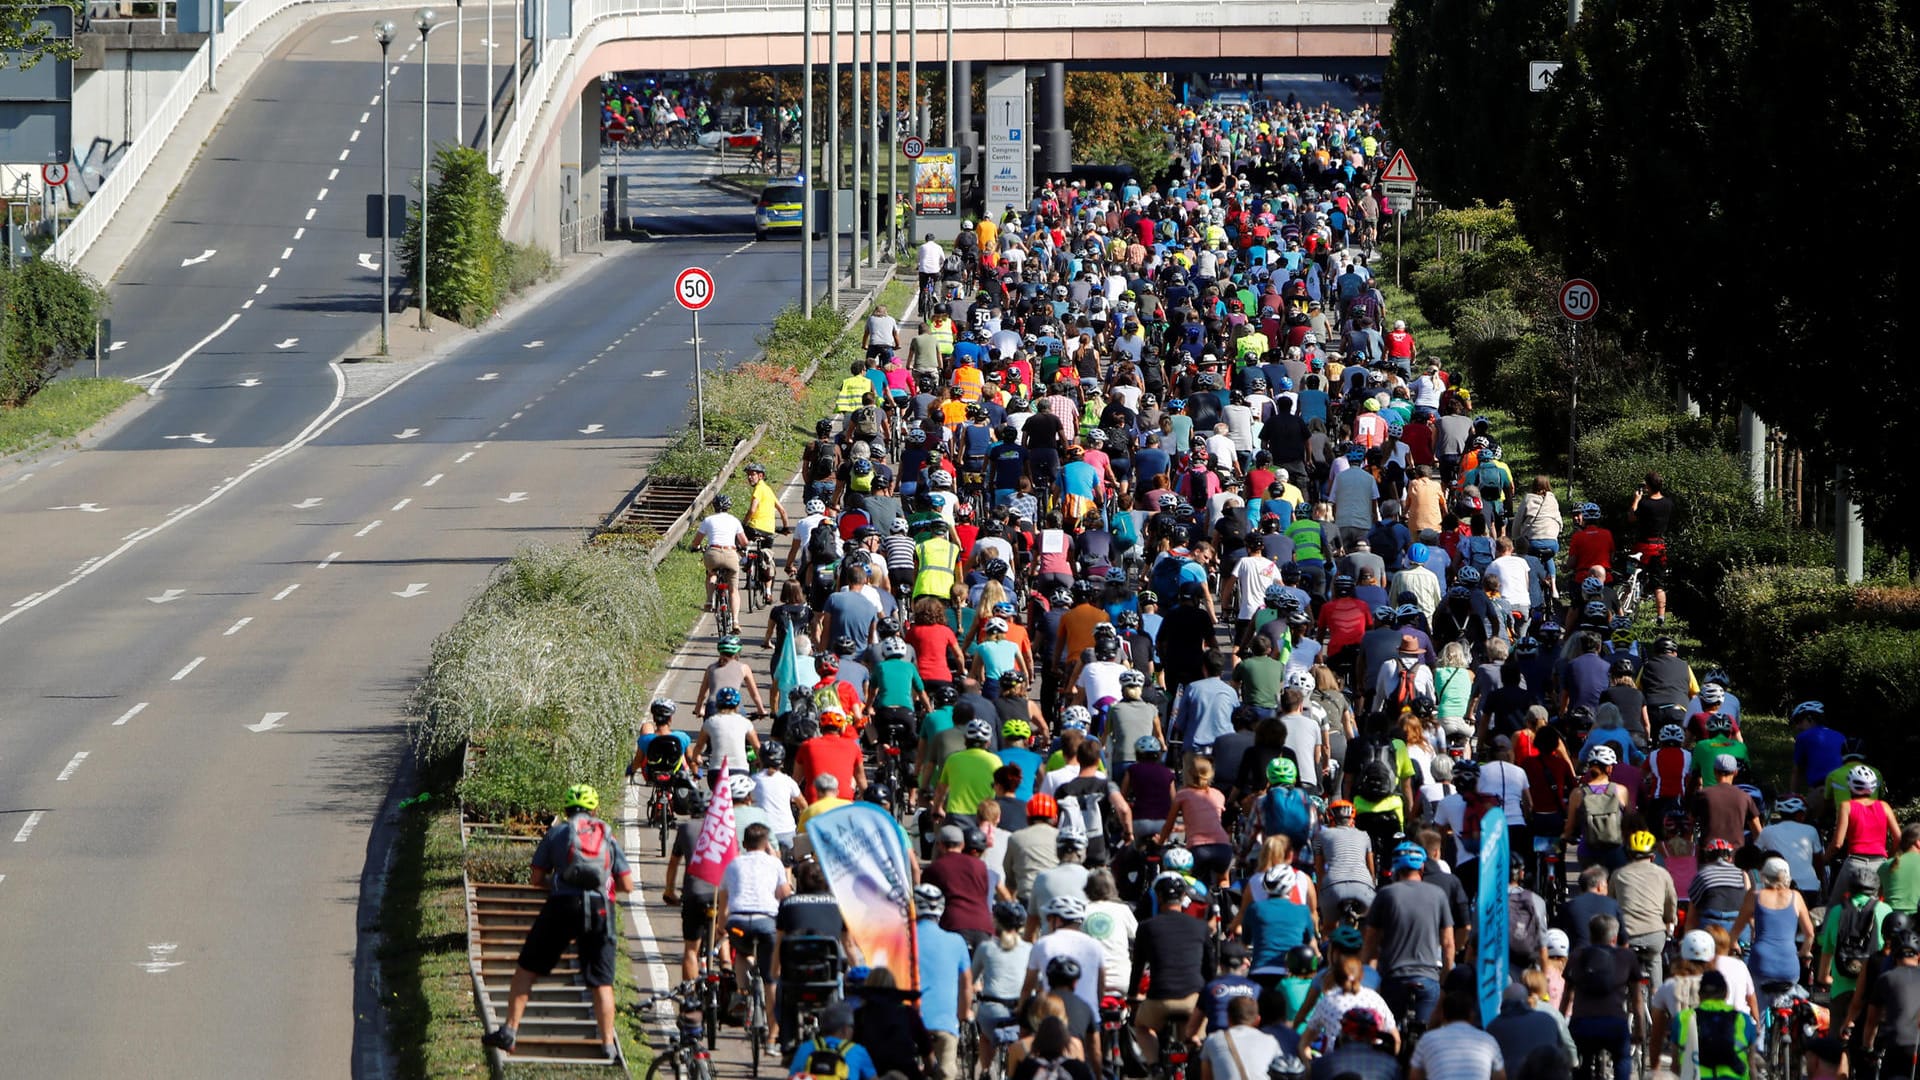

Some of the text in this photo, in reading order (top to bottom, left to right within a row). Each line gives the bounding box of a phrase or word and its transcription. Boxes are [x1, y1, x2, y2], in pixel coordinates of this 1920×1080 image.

[907, 143, 919, 154] 50
[685, 280, 706, 298] 50
[1568, 291, 1591, 310] 50
[974, 312, 991, 326] 39
